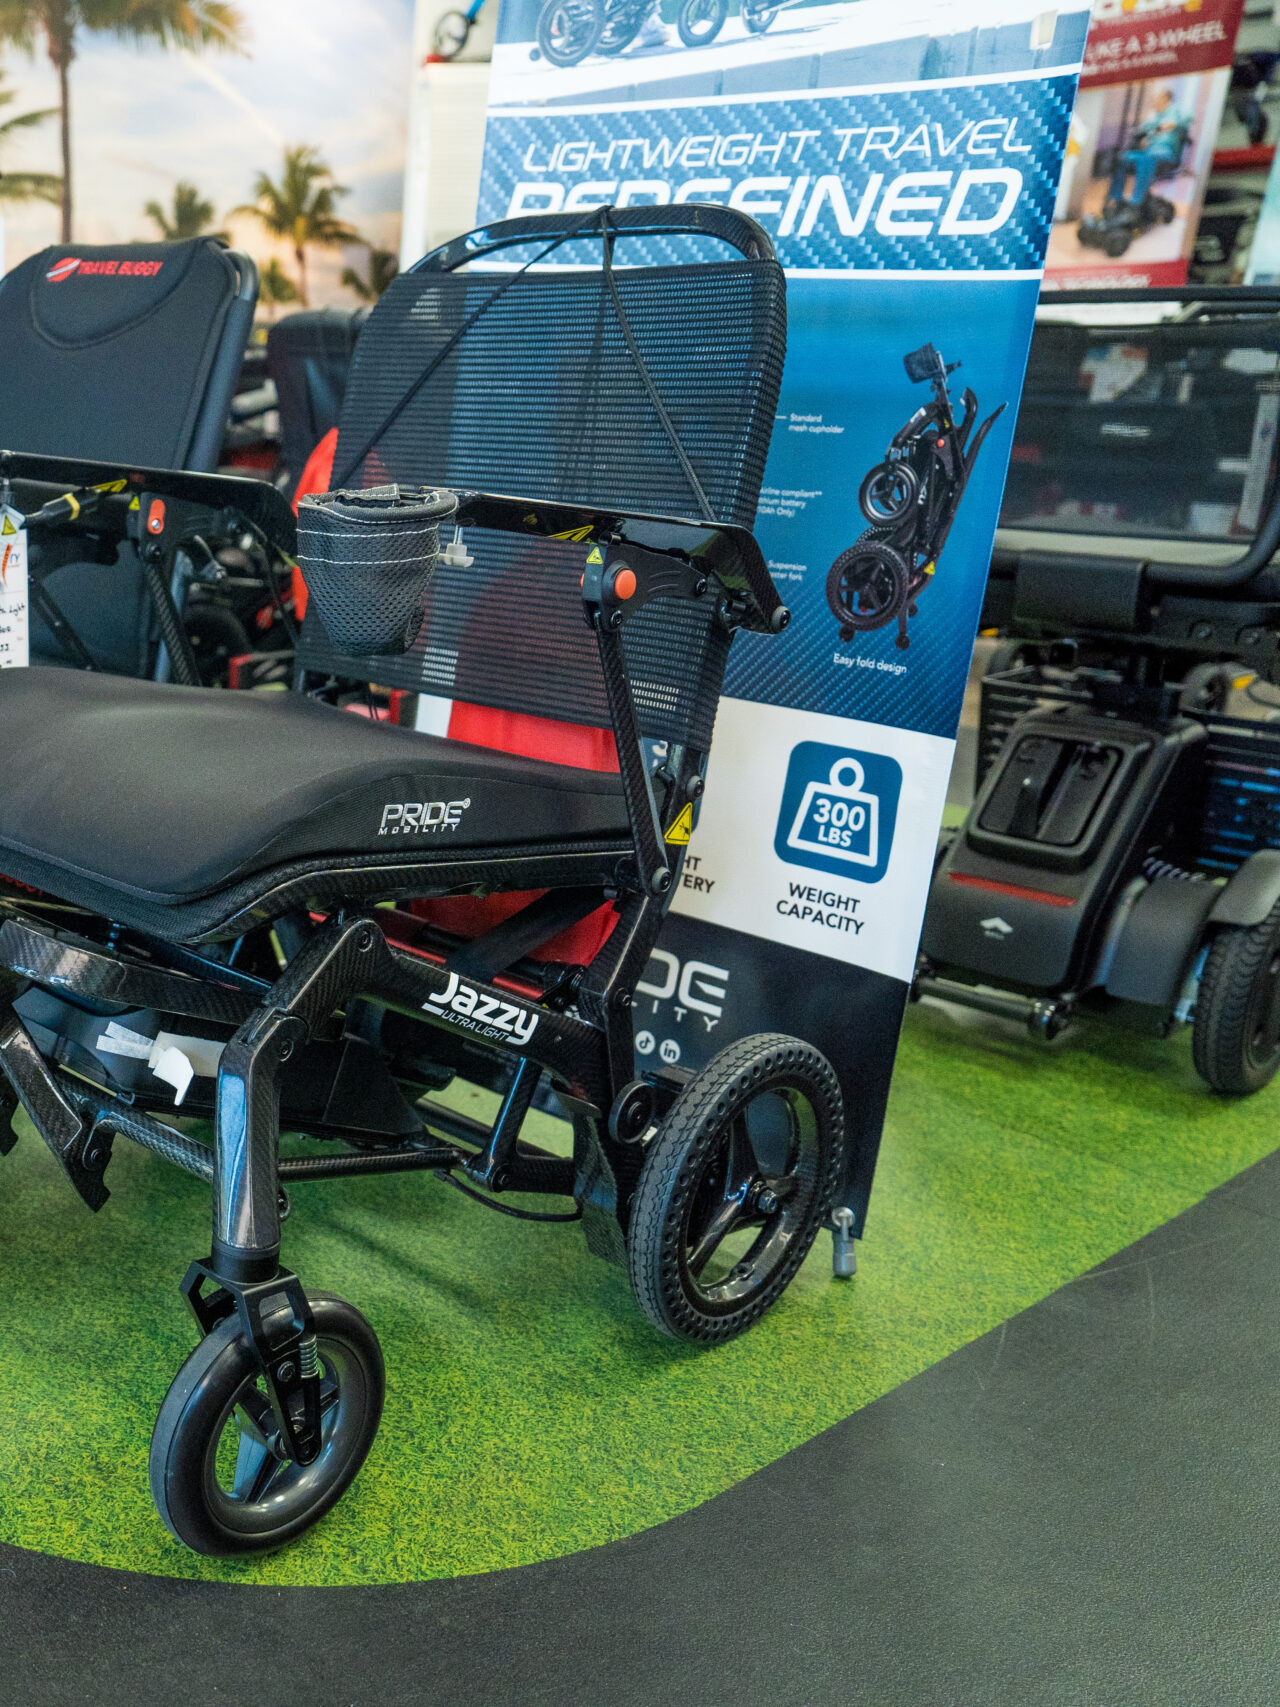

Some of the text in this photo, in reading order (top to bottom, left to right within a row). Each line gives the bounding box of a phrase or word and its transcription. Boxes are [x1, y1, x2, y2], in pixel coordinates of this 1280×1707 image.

[523, 116, 1033, 173] LIGHTWEIGHT TRAVEL
[78, 260, 164, 277] TRAVEL BUGGY
[790, 413, 822, 422] Standard
[833, 653, 908, 676] Easy fold design
[380, 801, 465, 828] PRIDE
[813, 798, 866, 833] 300
[378, 823, 460, 836] MOBILITY
[817, 827, 853, 848] LBS
[788, 881, 861, 915] WEIGHT
[776, 899, 865, 936] CAPACITY
[428, 972, 540, 1045] Jazzy
